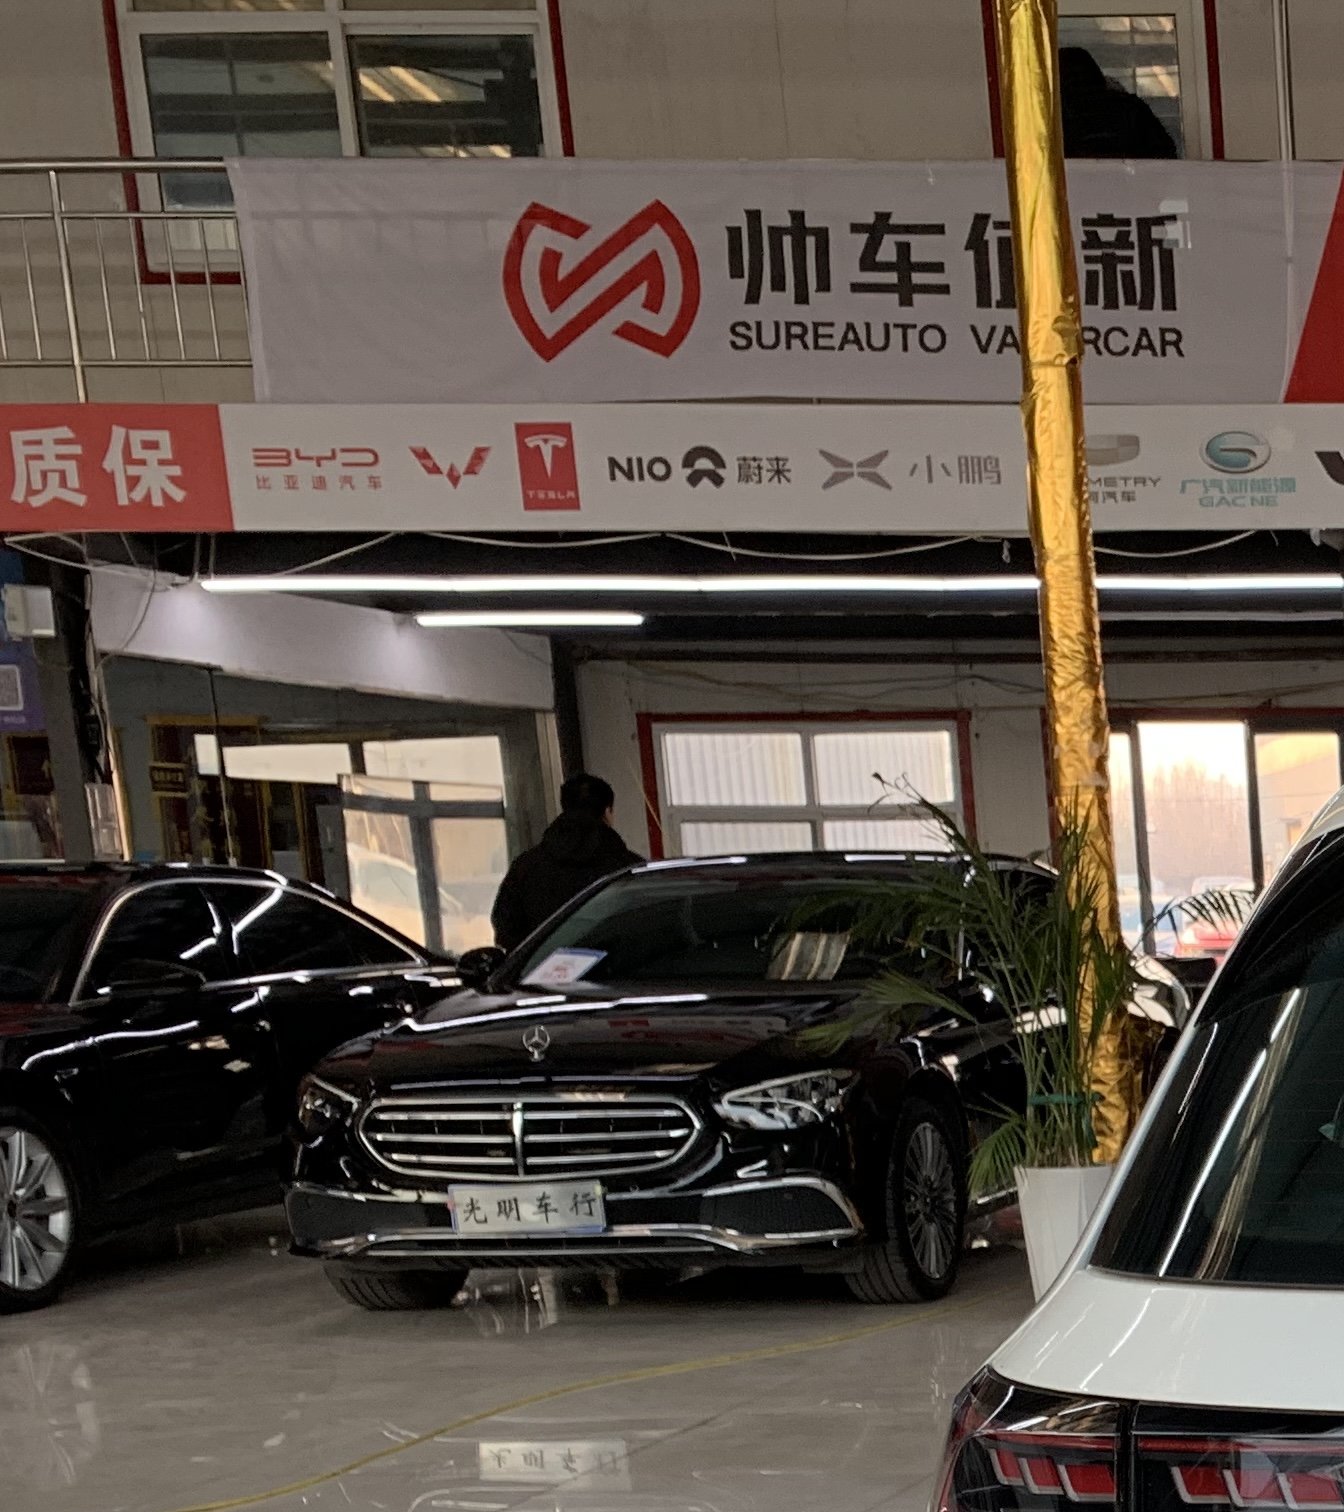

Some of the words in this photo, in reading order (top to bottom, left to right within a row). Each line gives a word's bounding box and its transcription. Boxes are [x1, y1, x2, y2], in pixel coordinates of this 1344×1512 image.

[729, 320, 947, 354] SUREAUTO
[9, 424, 187, 508] 质保
[252, 447, 380, 468] BYD
[606, 455, 673, 483] NIO
[735, 455, 793, 485] 蔚来
[908, 453, 1001, 485] 小鹏
[255, 474, 383, 490] 比亚迪汽车
[1087, 476, 1162, 488] METRY
[1179, 476, 1297, 495] 广汽新能源
[462, 1190, 596, 1224] 光明车行
